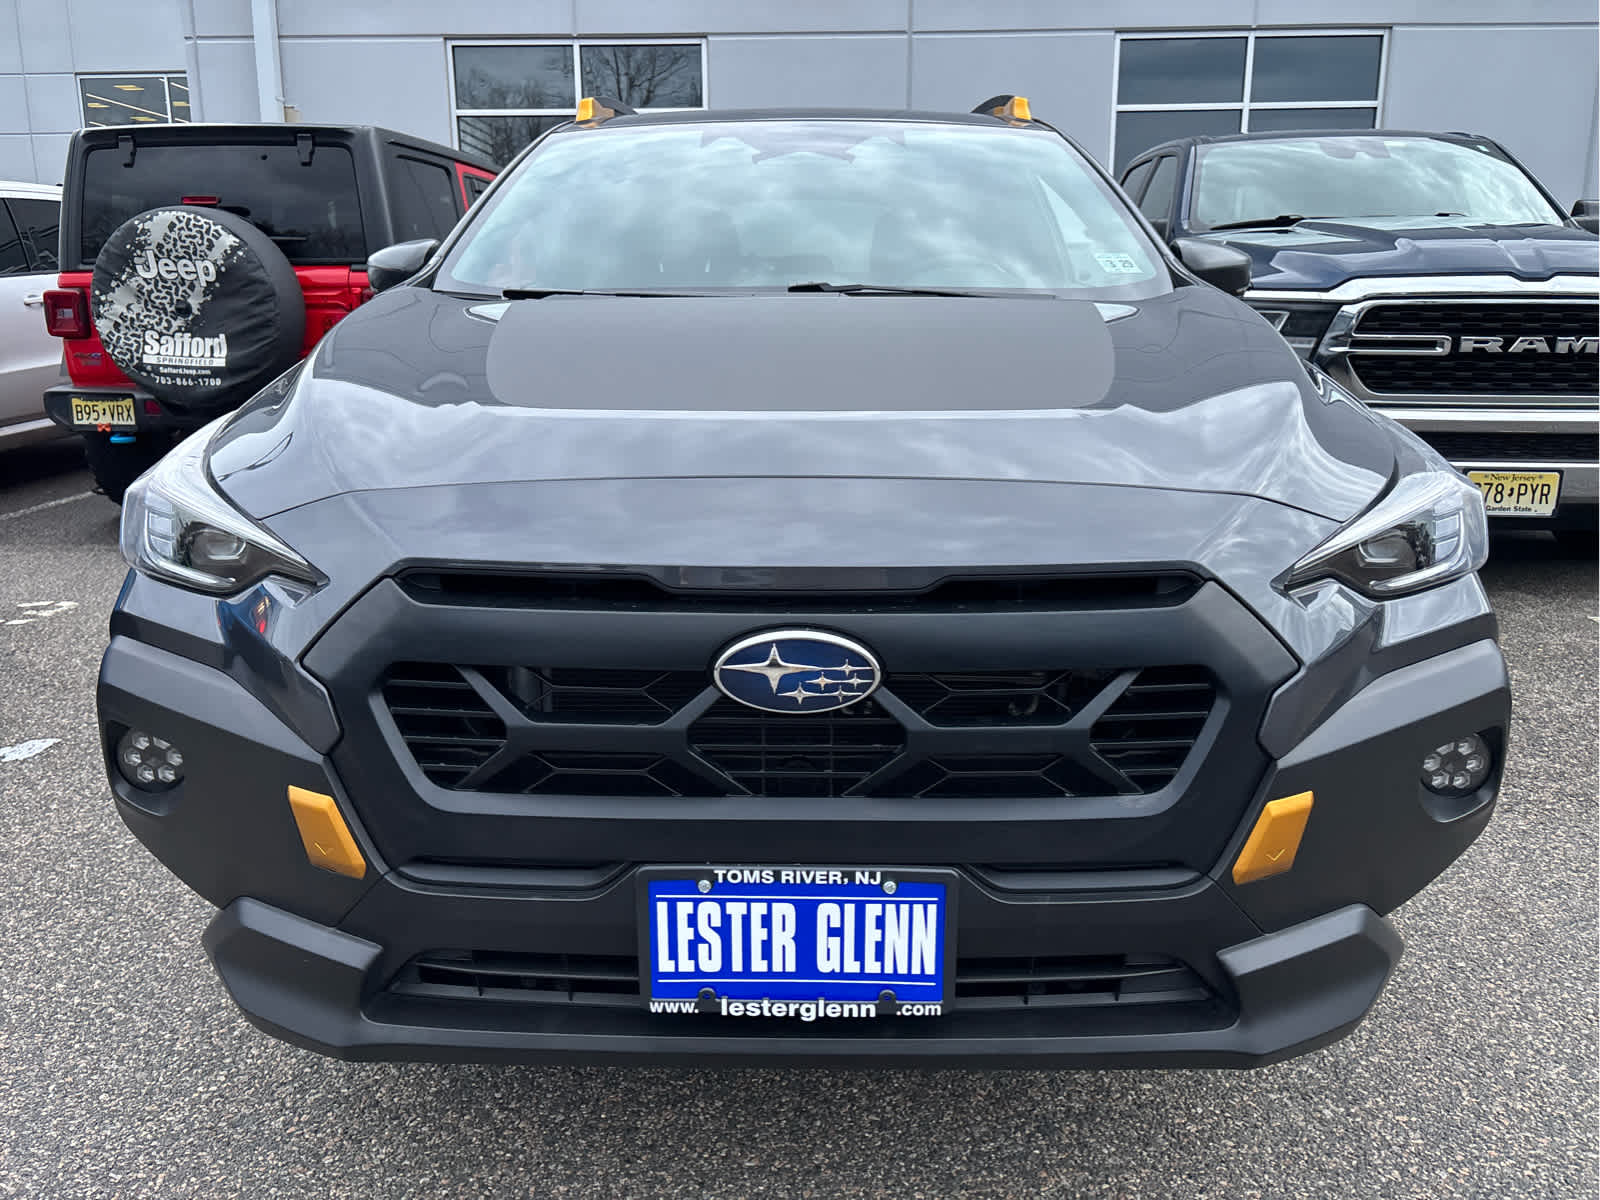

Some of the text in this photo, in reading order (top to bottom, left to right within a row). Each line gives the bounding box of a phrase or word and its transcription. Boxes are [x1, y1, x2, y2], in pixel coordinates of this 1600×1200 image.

[134, 250, 217, 287] Jeep
[144, 330, 228, 358] Safford
[1459, 336, 1600, 354] RAM
[156, 357, 214, 365] SPRINGFIELD
[1511, 474, 1537, 482] Jersey
[714, 869, 882, 885] TOMS RIVER, NJ
[656, 901, 938, 975] LESTER GLENN
[650, 996, 942, 1022] www. lesterglenn .com
